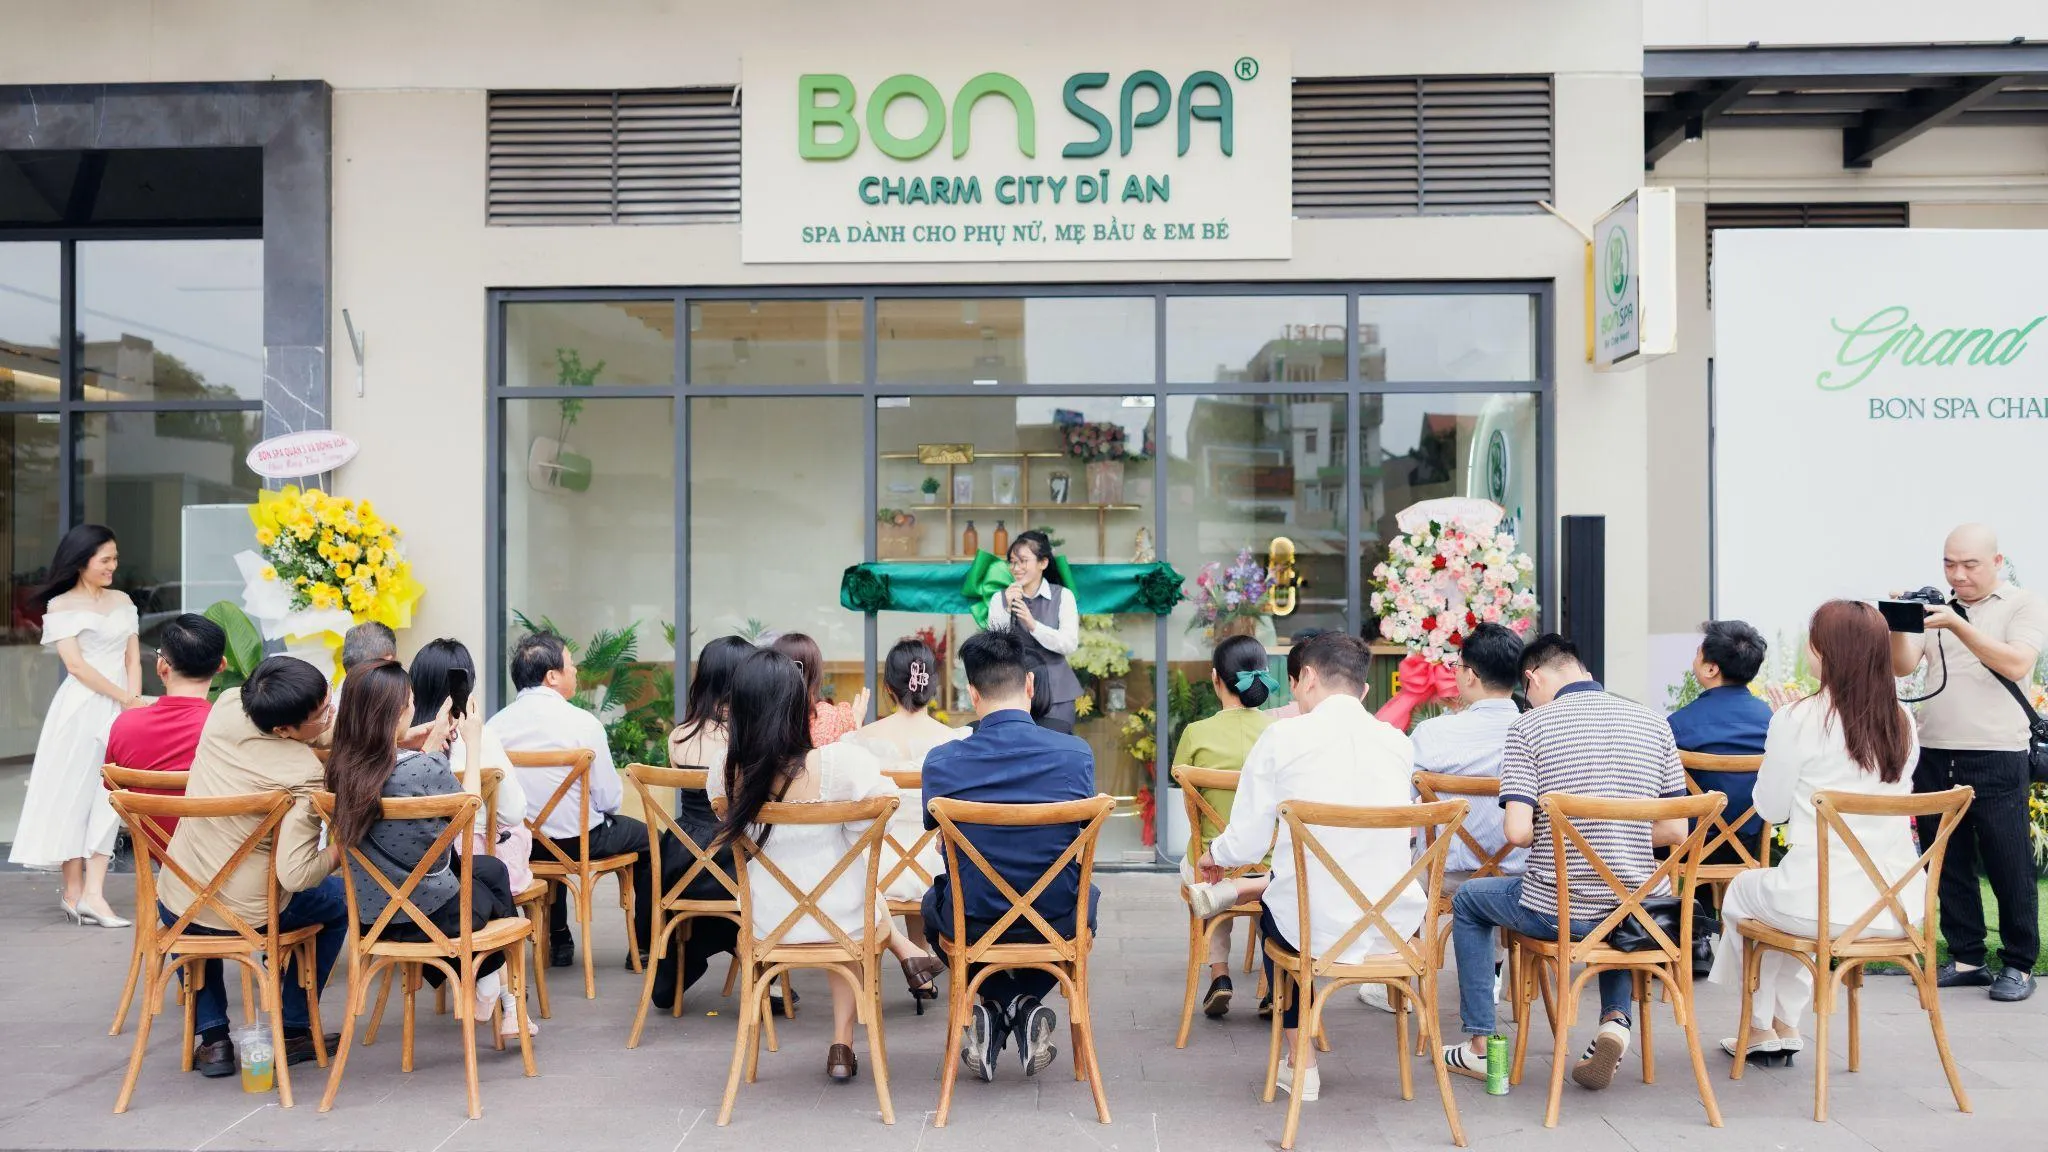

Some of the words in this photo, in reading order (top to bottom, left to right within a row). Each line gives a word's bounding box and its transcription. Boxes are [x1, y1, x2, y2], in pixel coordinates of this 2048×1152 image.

[798, 72, 1036, 161] BON
[1062, 70, 1234, 158] SPA
[858, 175, 982, 205] CHARM
[995, 175, 1067, 205] CITY
[1121, 174, 1170, 203] AN
[802, 226, 841, 243] SPA
[847, 221, 905, 243] DÀNH
[912, 225, 956, 242] CHO
[963, 225, 1005, 246] PHỤ
[1012, 220, 1046, 243] NỮ,
[1055, 224, 1086, 244] MẸ
[1093, 216, 1135, 241] BẦU
[1142, 224, 1156, 240] &
[1163, 223, 1195, 240] EM
[1201, 218, 1230, 240] BÉ
[1816, 305, 2048, 391] Grand
[1869, 397, 1925, 419] BON
[1933, 397, 1980, 419] SPA
